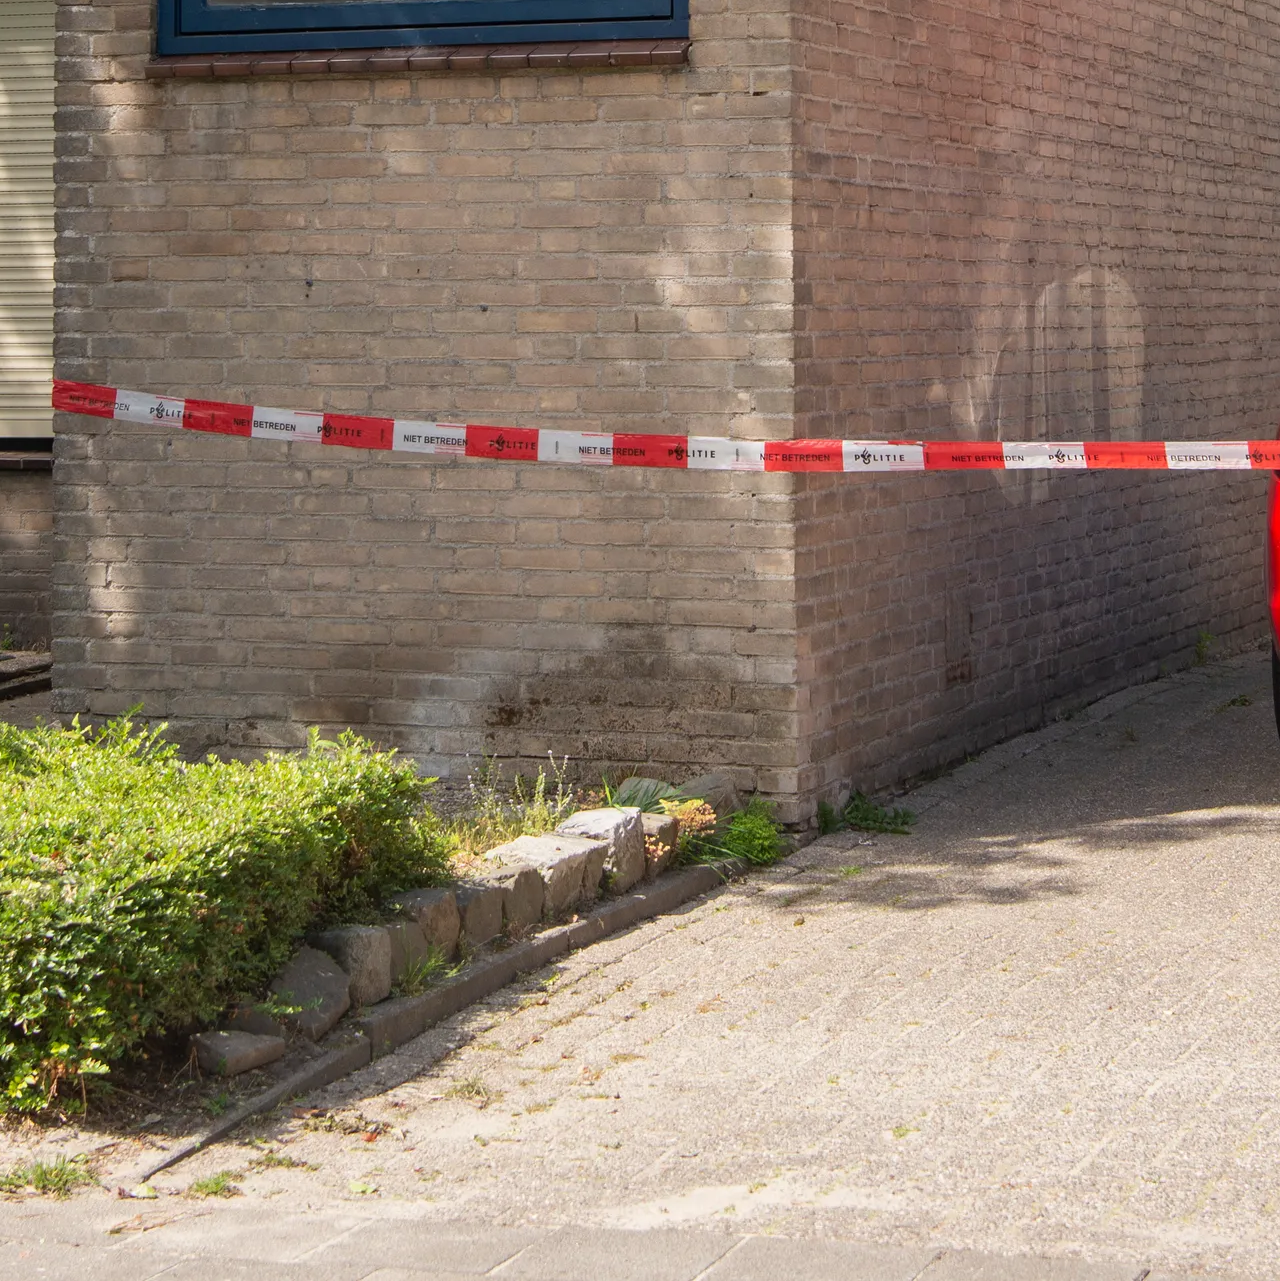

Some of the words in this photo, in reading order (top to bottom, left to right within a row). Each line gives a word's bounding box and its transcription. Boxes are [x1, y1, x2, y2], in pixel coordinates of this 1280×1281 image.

[233, 417, 251, 427] NIET
[253, 420, 296, 432] BETREDEN
[404, 434, 422, 444] NIET
[424, 436, 468, 446] BETREDEN
[578, 446, 598, 454] NIET
[600, 447, 646, 456] BETREDEN
[760, 453, 779, 462] NIET
[782, 453, 830, 462] BETREDEN
[975, 454, 1024, 462] BETREDEN
[1147, 454, 1167, 462] NIET
[1171, 454, 1220, 462] BETREDEN
